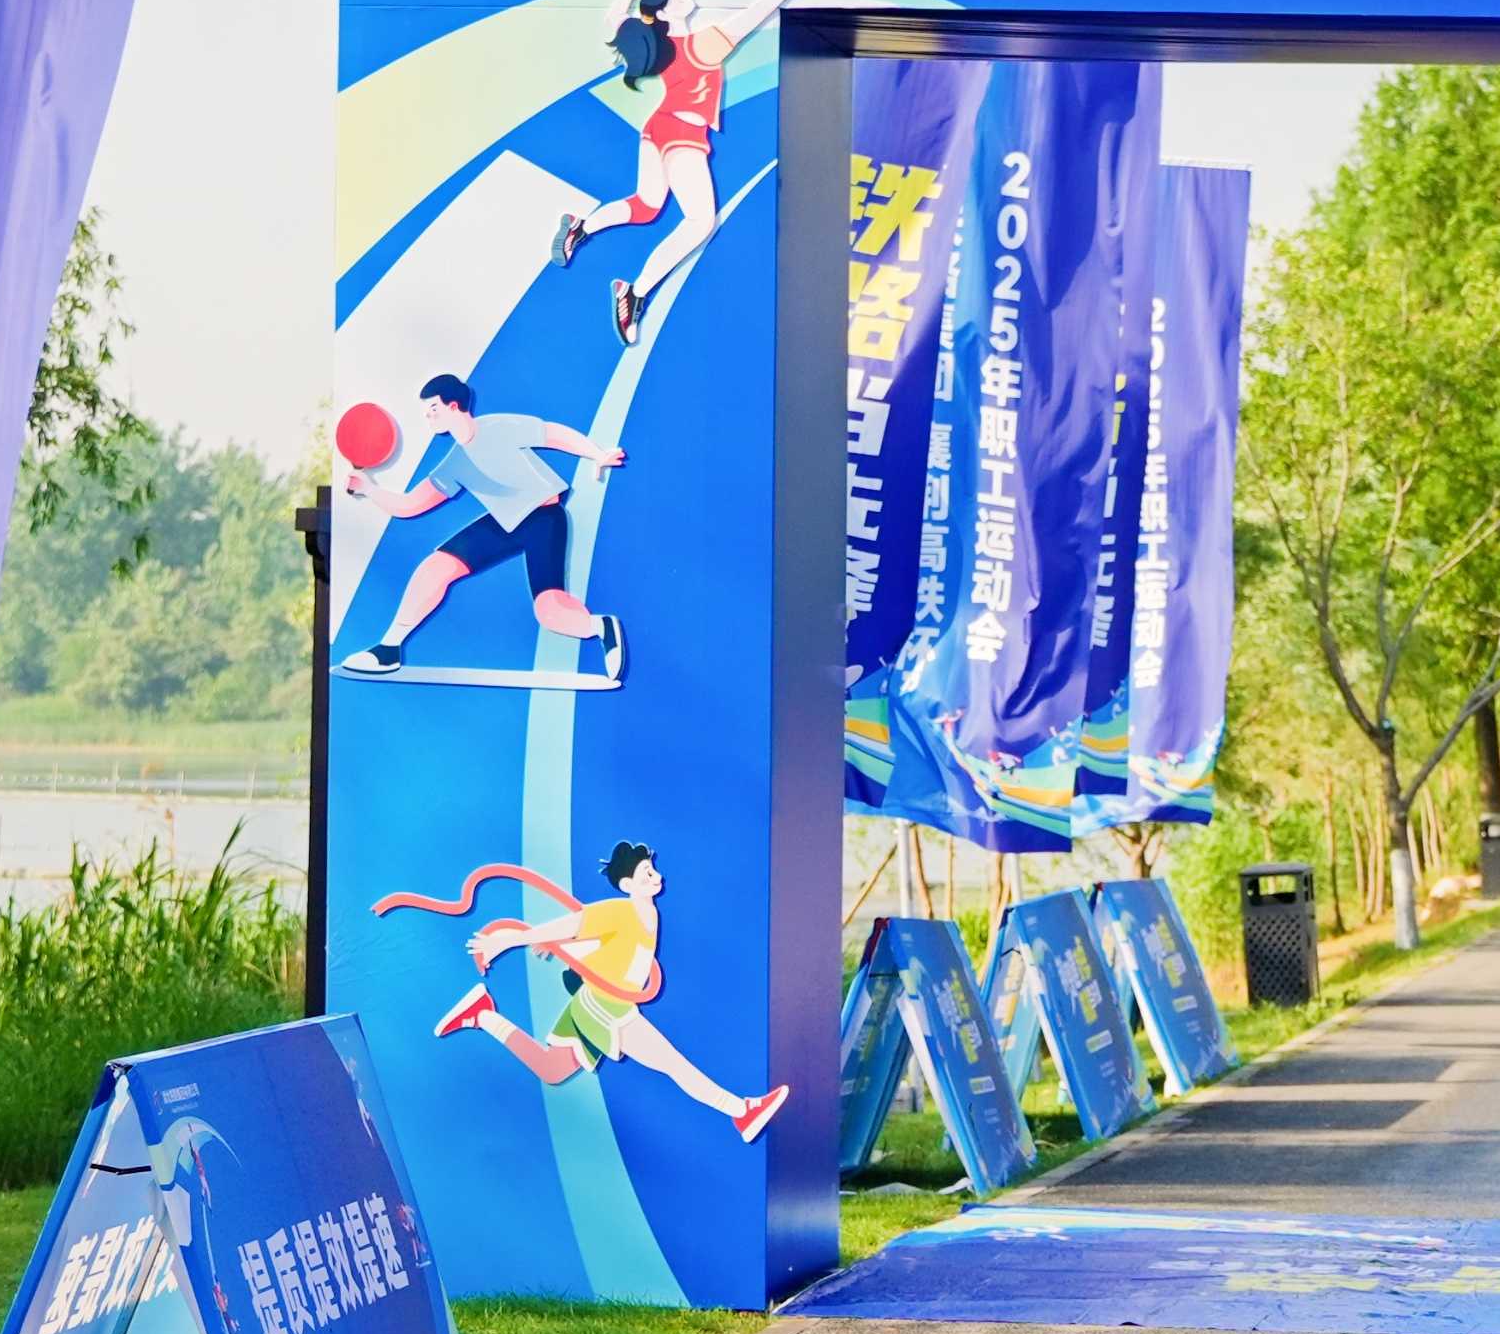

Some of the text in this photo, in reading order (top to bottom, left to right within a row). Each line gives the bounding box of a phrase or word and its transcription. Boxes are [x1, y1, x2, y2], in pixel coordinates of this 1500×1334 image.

[965, 151, 1032, 664] 2025年职工运动会
